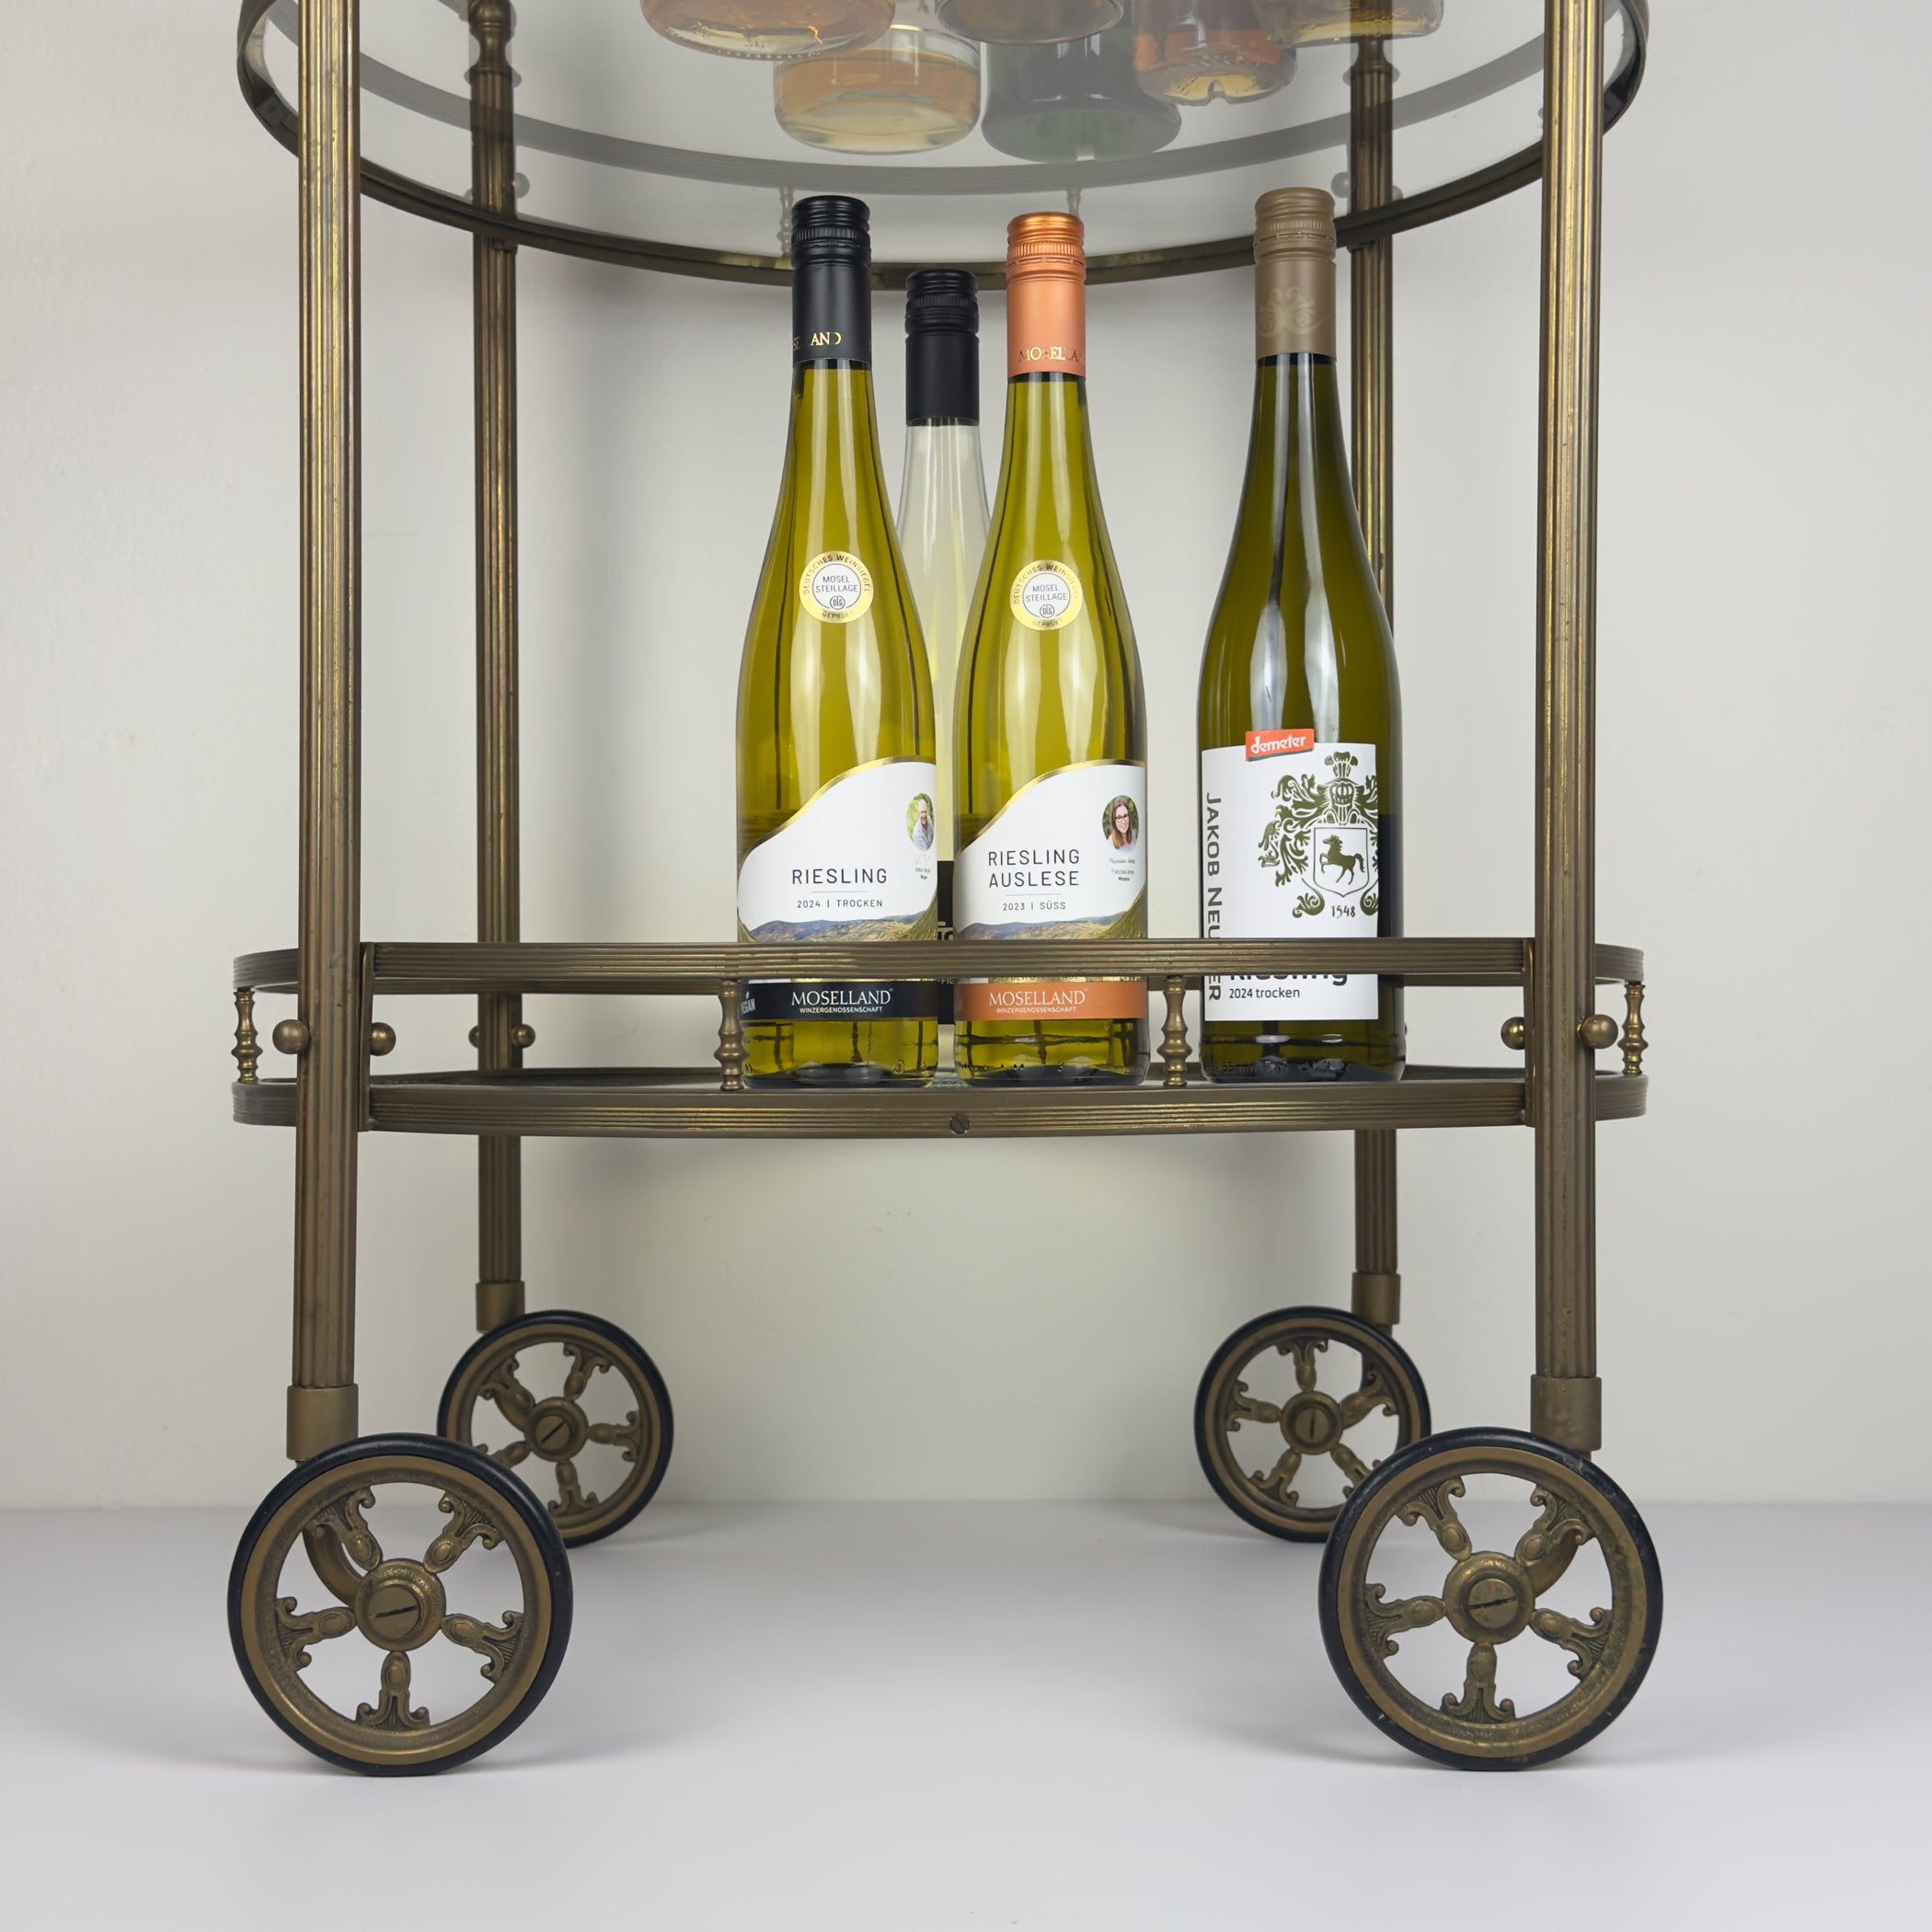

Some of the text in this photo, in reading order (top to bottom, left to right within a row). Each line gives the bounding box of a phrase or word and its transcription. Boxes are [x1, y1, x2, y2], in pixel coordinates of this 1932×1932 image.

[822, 575, 850, 583] MOSEL
[815, 584, 858, 593] STEILLAGE
[1032, 584, 1060, 592] MOSEL
[1025, 592, 1067, 603] STEILLAGE
[1250, 734, 1306, 754] demeter
[1206, 792, 1222, 877] JAKOB
[988, 848, 1080, 867] RIESLING
[792, 868, 888, 885] RIESLING
[988, 870, 1080, 889] AUSLESE
[797, 898, 883, 908] 2024 TROCKEN
[1003, 899, 1067, 912] 2023 SÜSS
[1330, 904, 1356, 918] 1548
[1207, 887, 1223, 1001] NEUER
[791, 990, 891, 1006] MOSELLAND
[989, 990, 1086, 1006] MOSELLAND
[1229, 987, 1301, 999] 2024 trocken
[799, 1006, 883, 1014] WINZERGENOSSENSCHAFT
[995, 1006, 1077, 1015] WINZERGENOSSENSCHAFT
